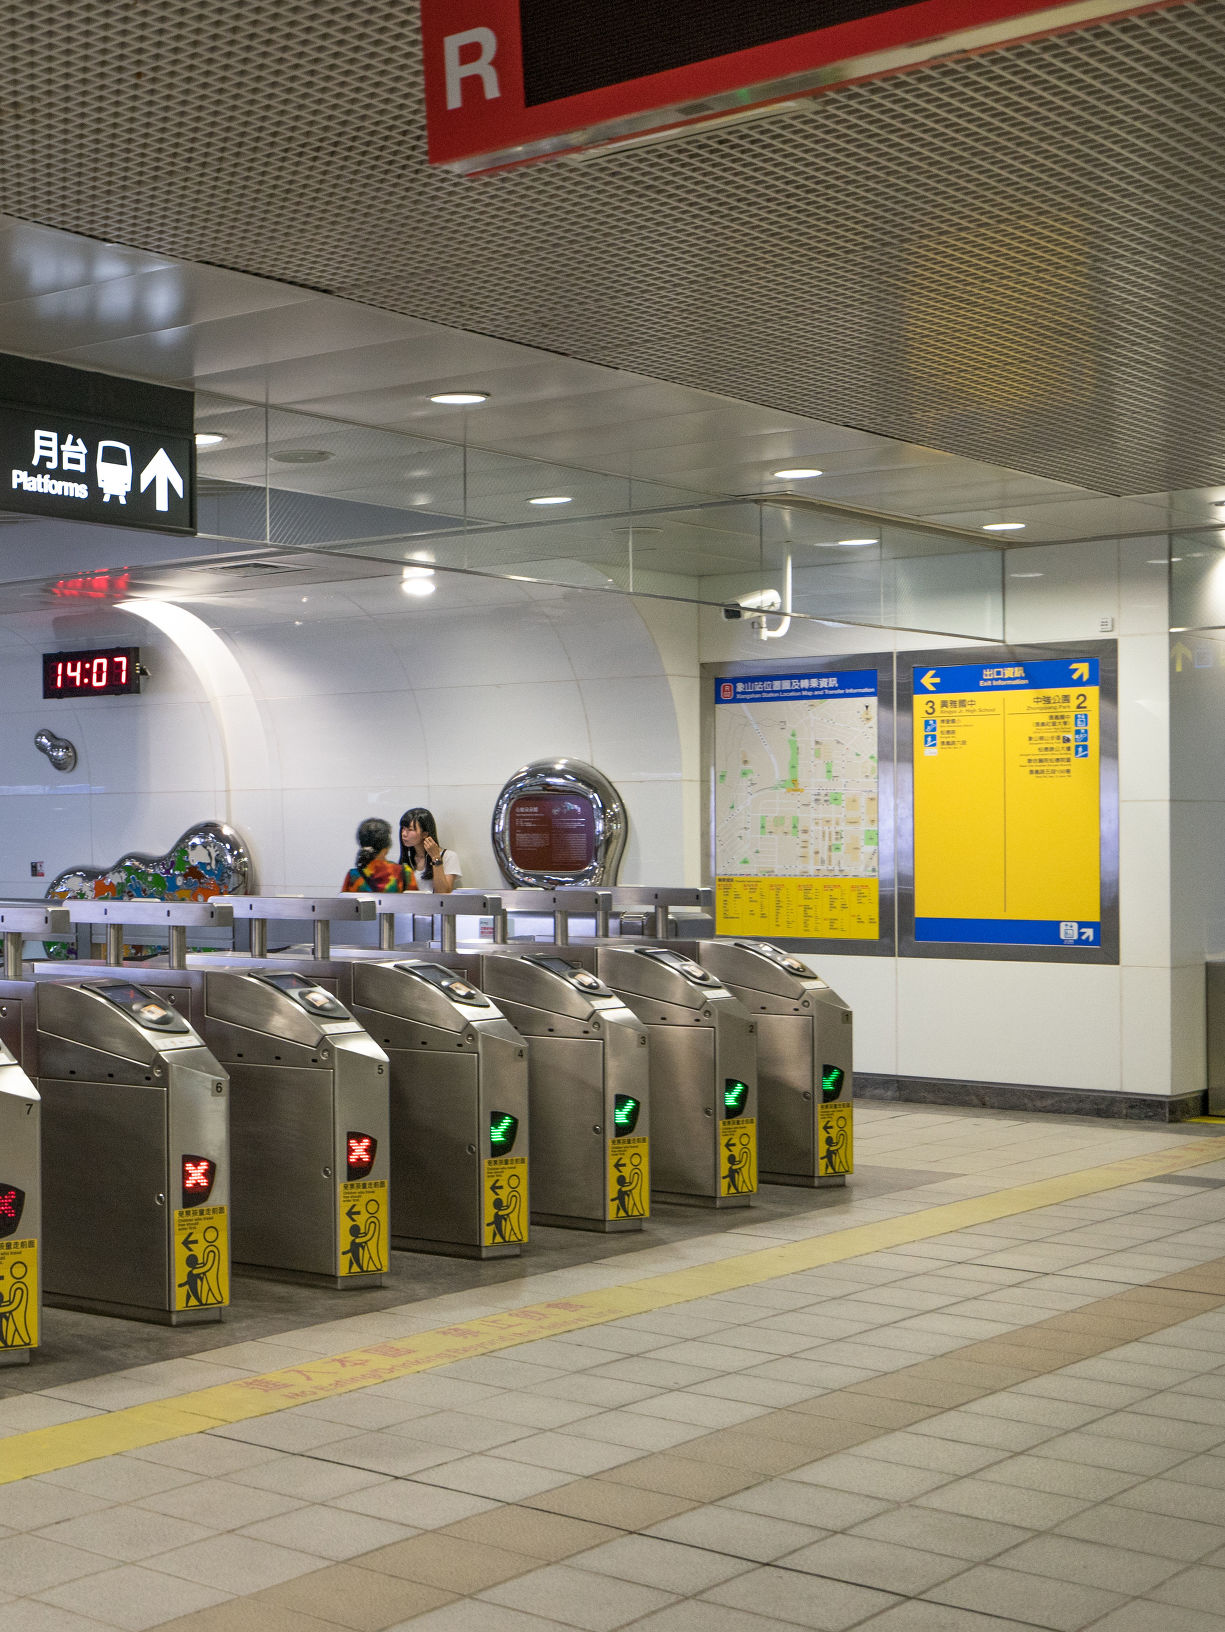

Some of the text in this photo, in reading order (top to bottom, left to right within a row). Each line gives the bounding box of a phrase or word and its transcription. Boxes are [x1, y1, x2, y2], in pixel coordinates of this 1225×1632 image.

[442, 26, 501, 110] R
[31, 429, 88, 474] 月台
[12, 469, 89, 499] Platforms
[56, 656, 127, 688] 14:07
[982, 666, 1025, 679] 出口資訊
[925, 700, 936, 716] 3
[1076, 693, 1088, 710] 2
[748, 1024, 754, 1033] 2
[640, 1036, 646, 1045] 3
[517, 1049, 524, 1059] 4
[377, 1064, 384, 1075] 5
[216, 1082, 223, 1094] 6
[25, 1103, 34, 1116] 7
